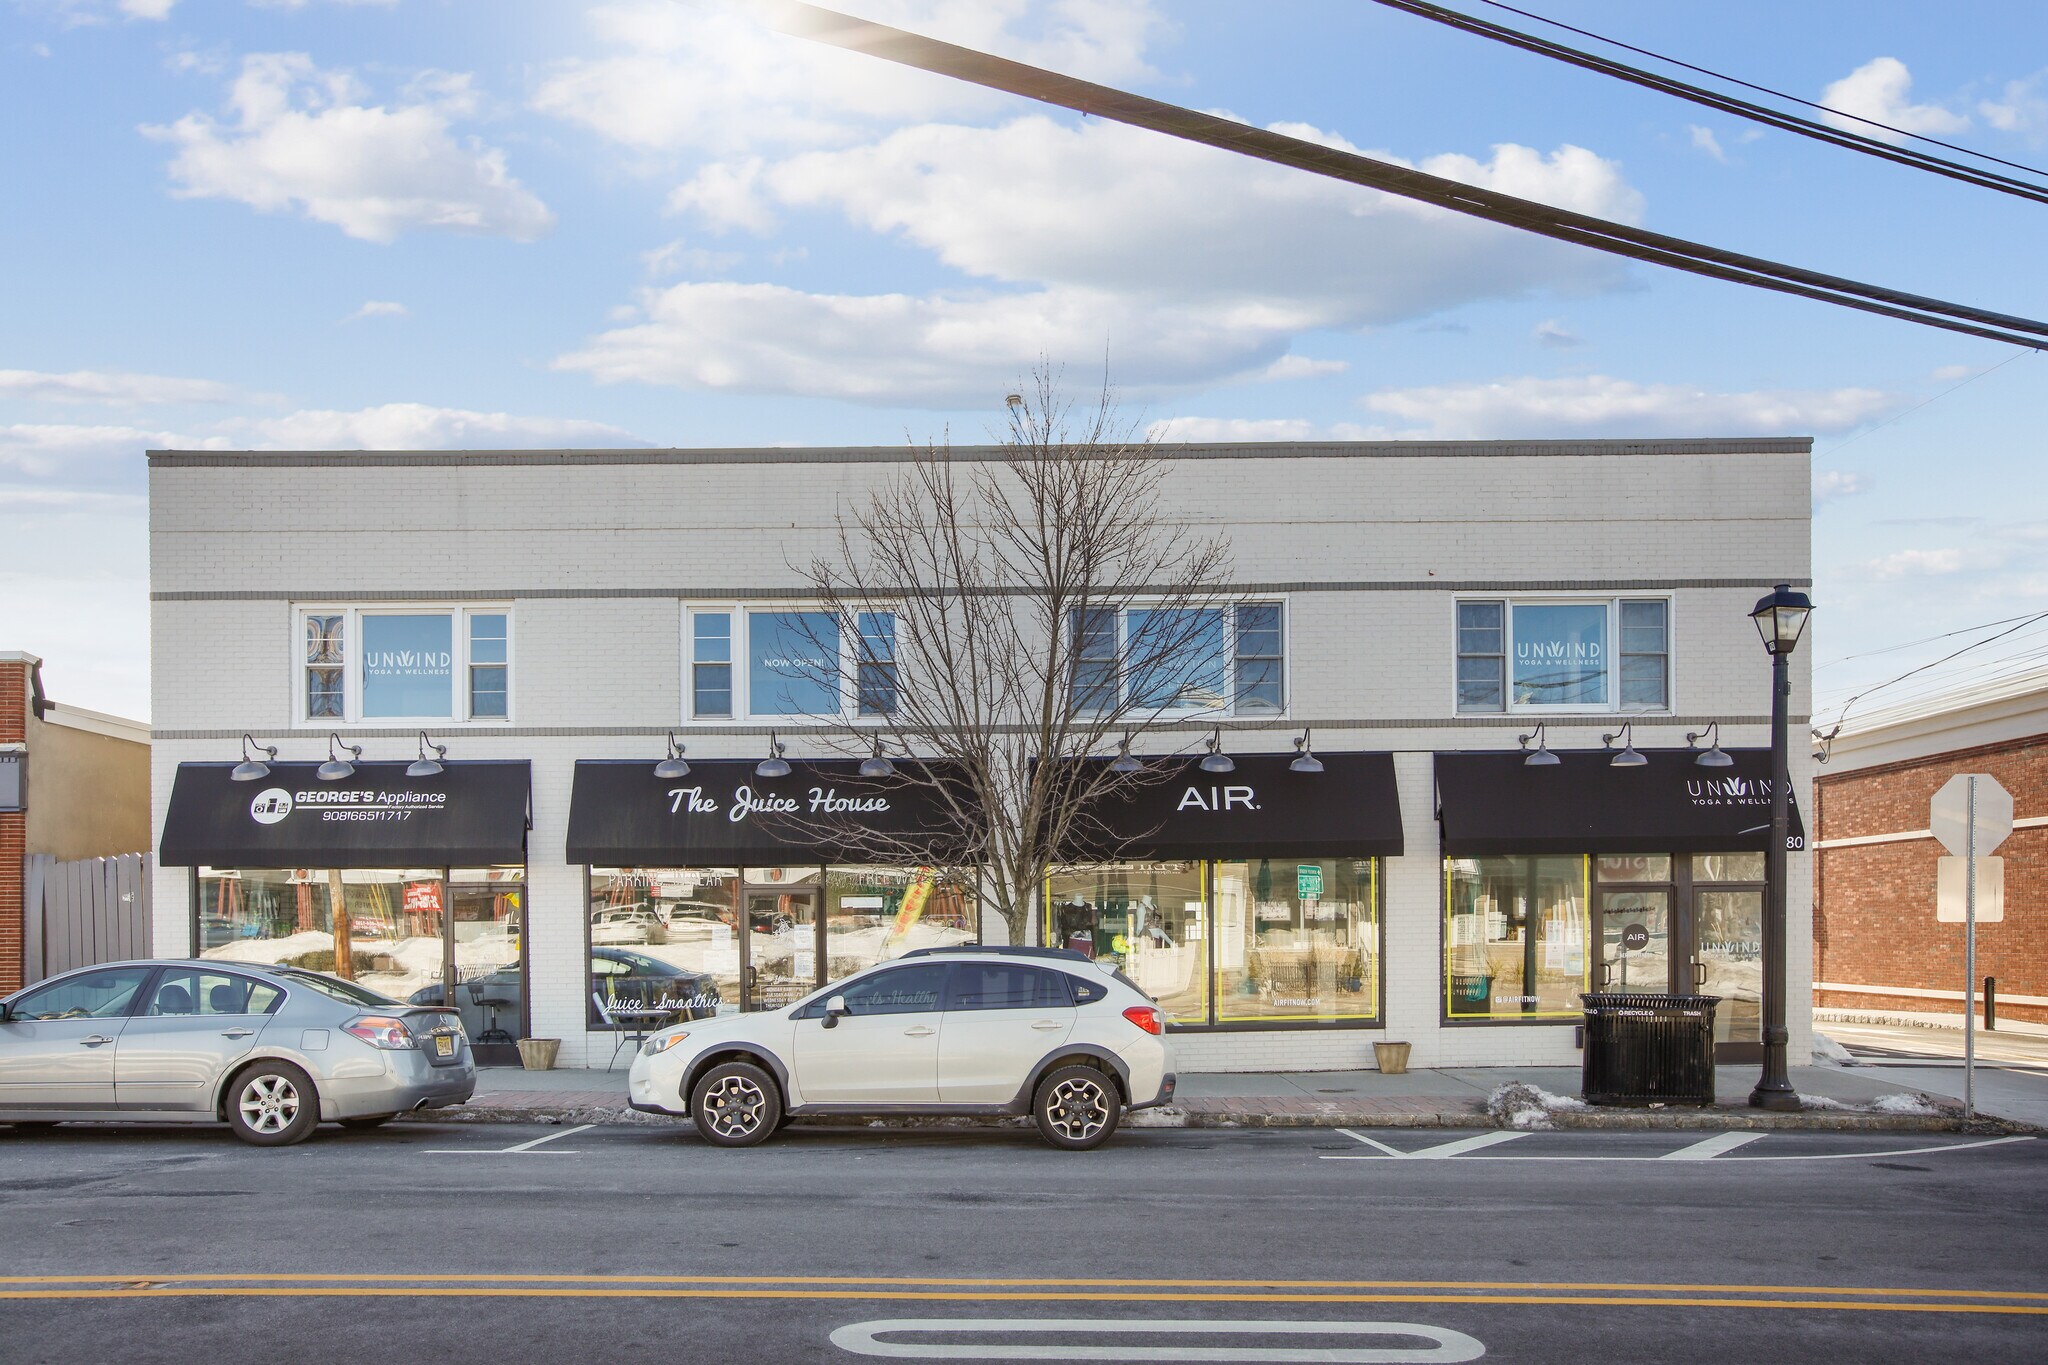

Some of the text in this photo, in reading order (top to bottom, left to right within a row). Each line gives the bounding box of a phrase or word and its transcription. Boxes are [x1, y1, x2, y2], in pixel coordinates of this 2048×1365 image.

[1518, 641, 1600, 658] UNWIND
[367, 650, 450, 667] UNWIND
[764, 659, 790, 667] NOW
[295, 791, 446, 805] GEORGE'S Appliance
[668, 785, 891, 822] The Juice House
[1177, 786, 1262, 811] AIR.
[1701, 940, 1760, 953] UNWIND
[602, 992, 726, 1016] Juice Smoothies
[890, 990, 938, 1010] Healthy
